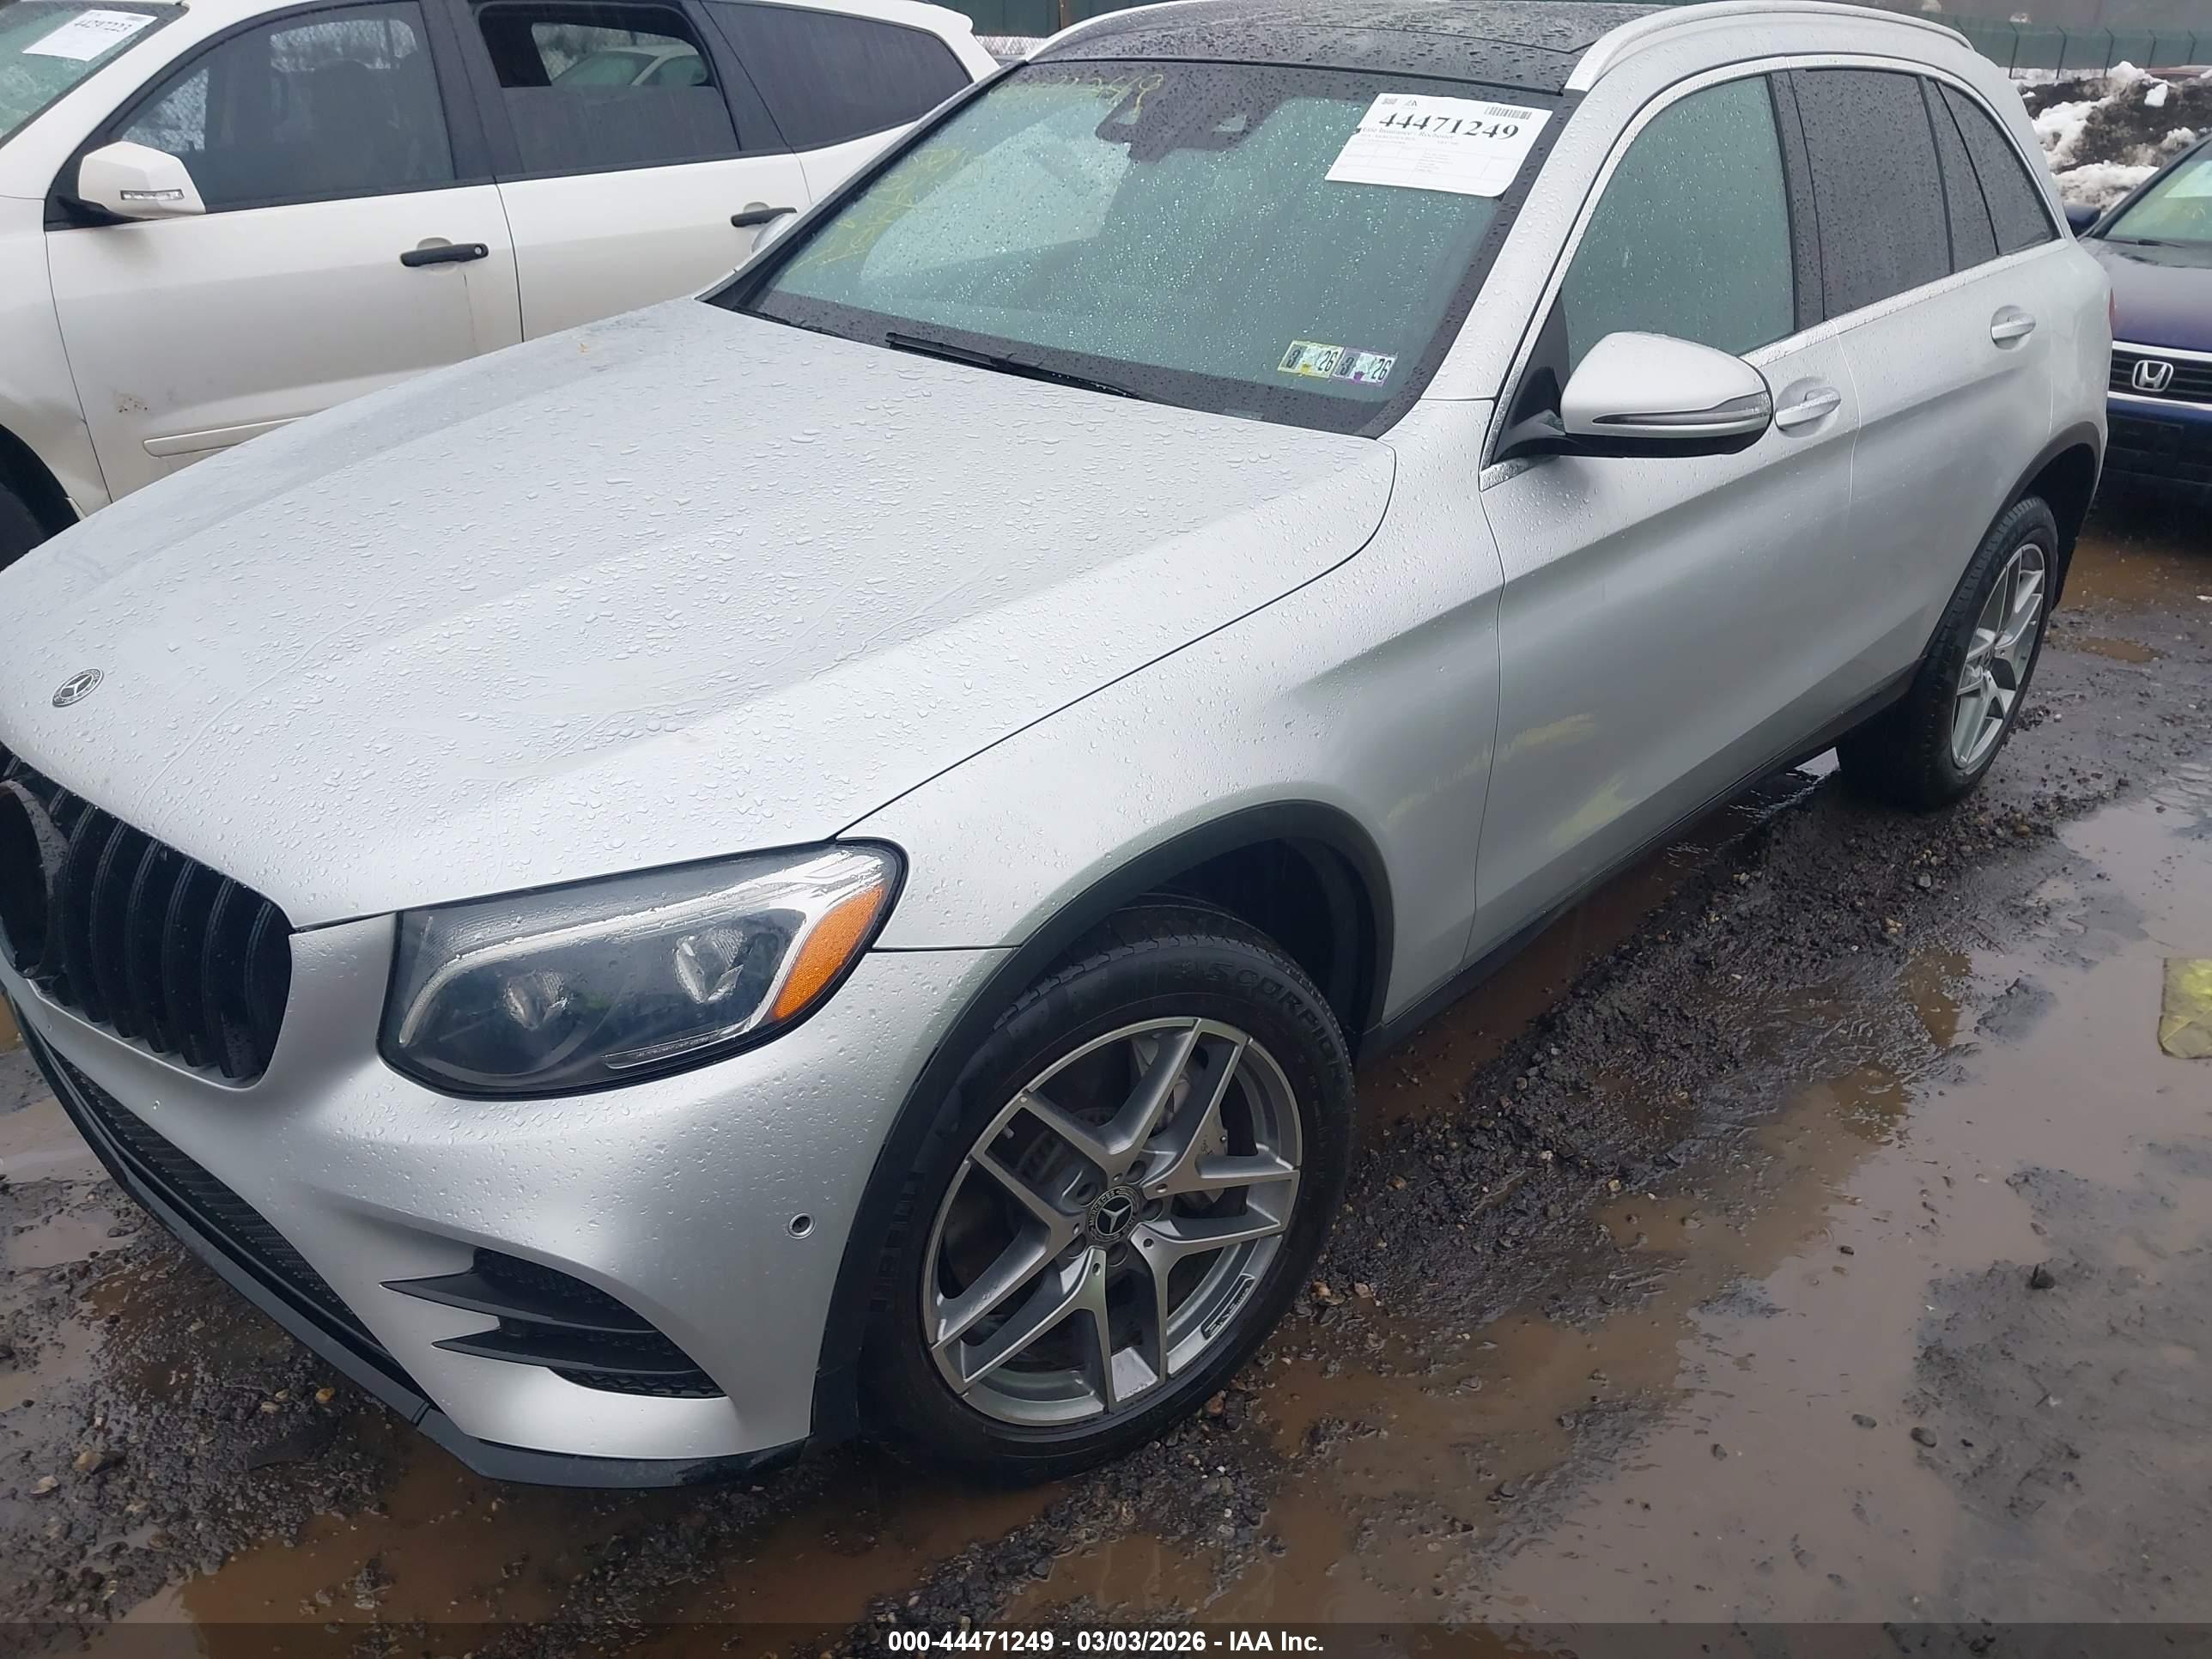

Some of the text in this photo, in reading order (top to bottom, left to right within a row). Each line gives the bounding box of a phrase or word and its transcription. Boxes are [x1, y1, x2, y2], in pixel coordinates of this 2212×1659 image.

[1378, 112, 1519, 140] 44471249
[1318, 350, 1339, 372] 26
[1371, 357, 1392, 380] 26
